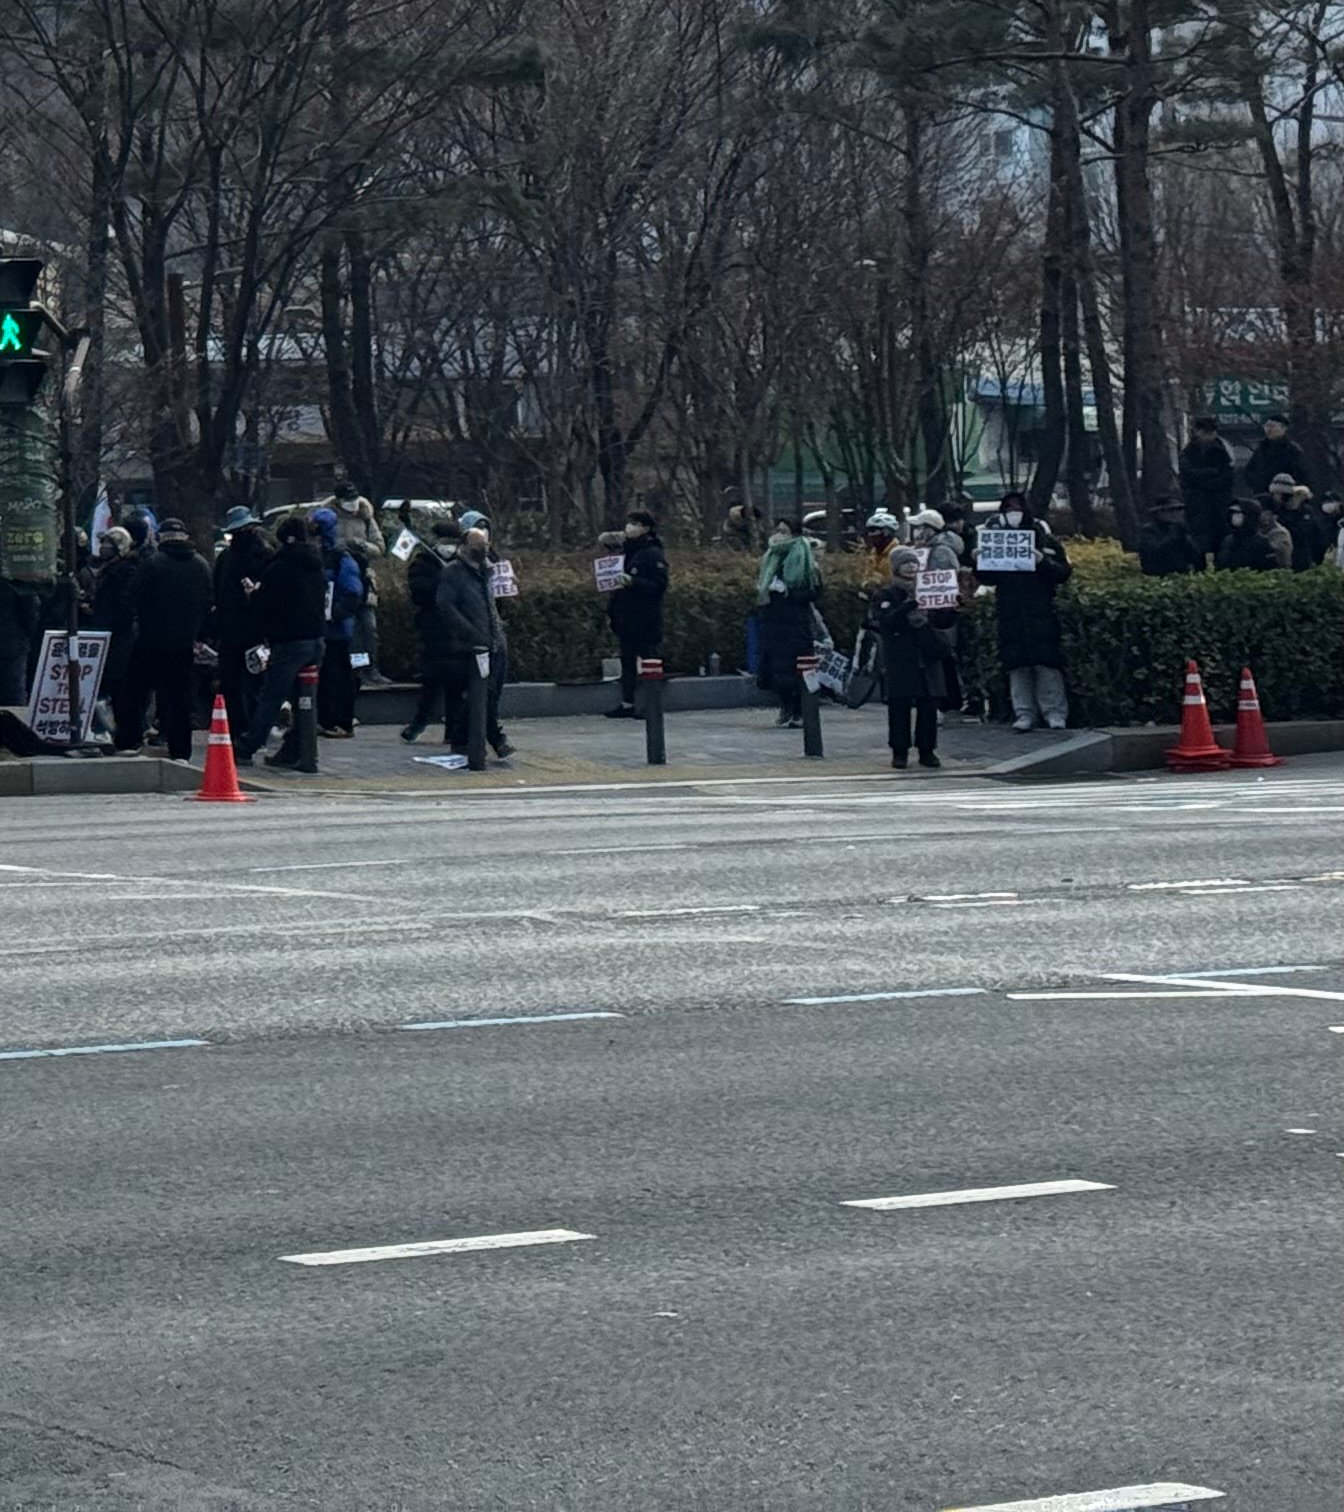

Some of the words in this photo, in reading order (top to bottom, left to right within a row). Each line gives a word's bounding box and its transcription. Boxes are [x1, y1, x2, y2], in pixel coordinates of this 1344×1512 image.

[981, 532, 1032, 546] 부정선거
[981, 546, 1032, 560] 검증하라
[922, 571, 953, 586] STOP
[919, 593, 957, 608] STEAL
[50, 663, 93, 682] STP
[38, 697, 88, 715] STEL
